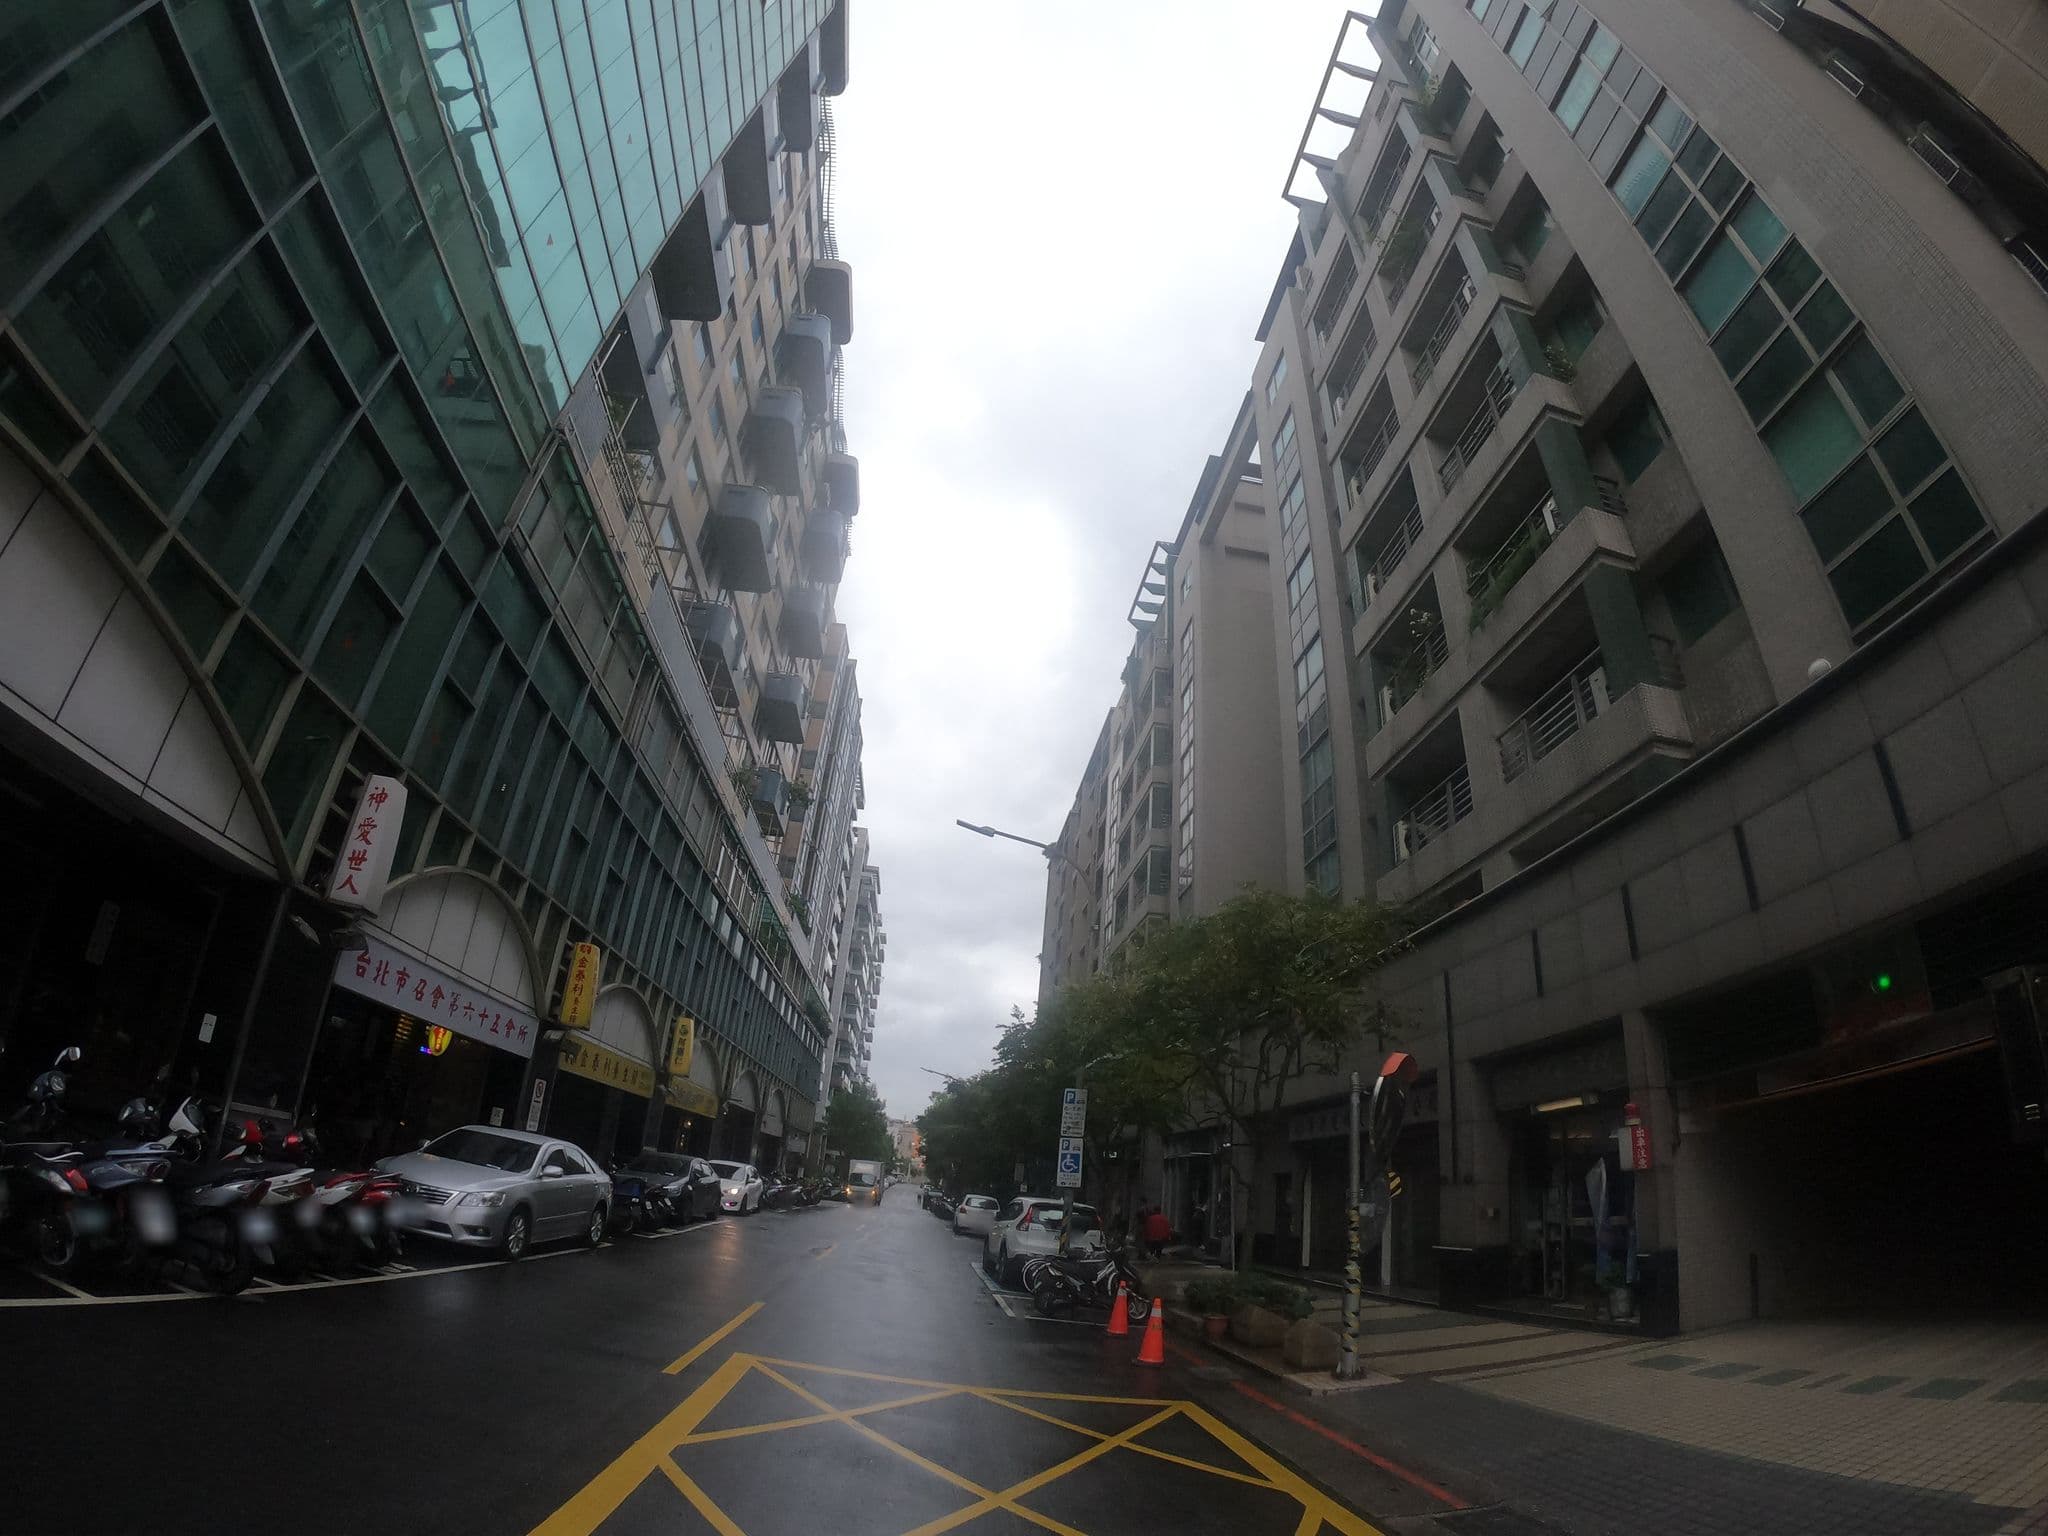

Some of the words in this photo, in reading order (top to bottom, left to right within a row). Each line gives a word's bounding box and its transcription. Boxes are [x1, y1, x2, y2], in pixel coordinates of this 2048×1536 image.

[336, 786, 389, 895] 神愛世人
[355, 949, 529, 1044] 台北市召會第六十五會所
[1636, 1127, 1647, 1169] 出車注意
